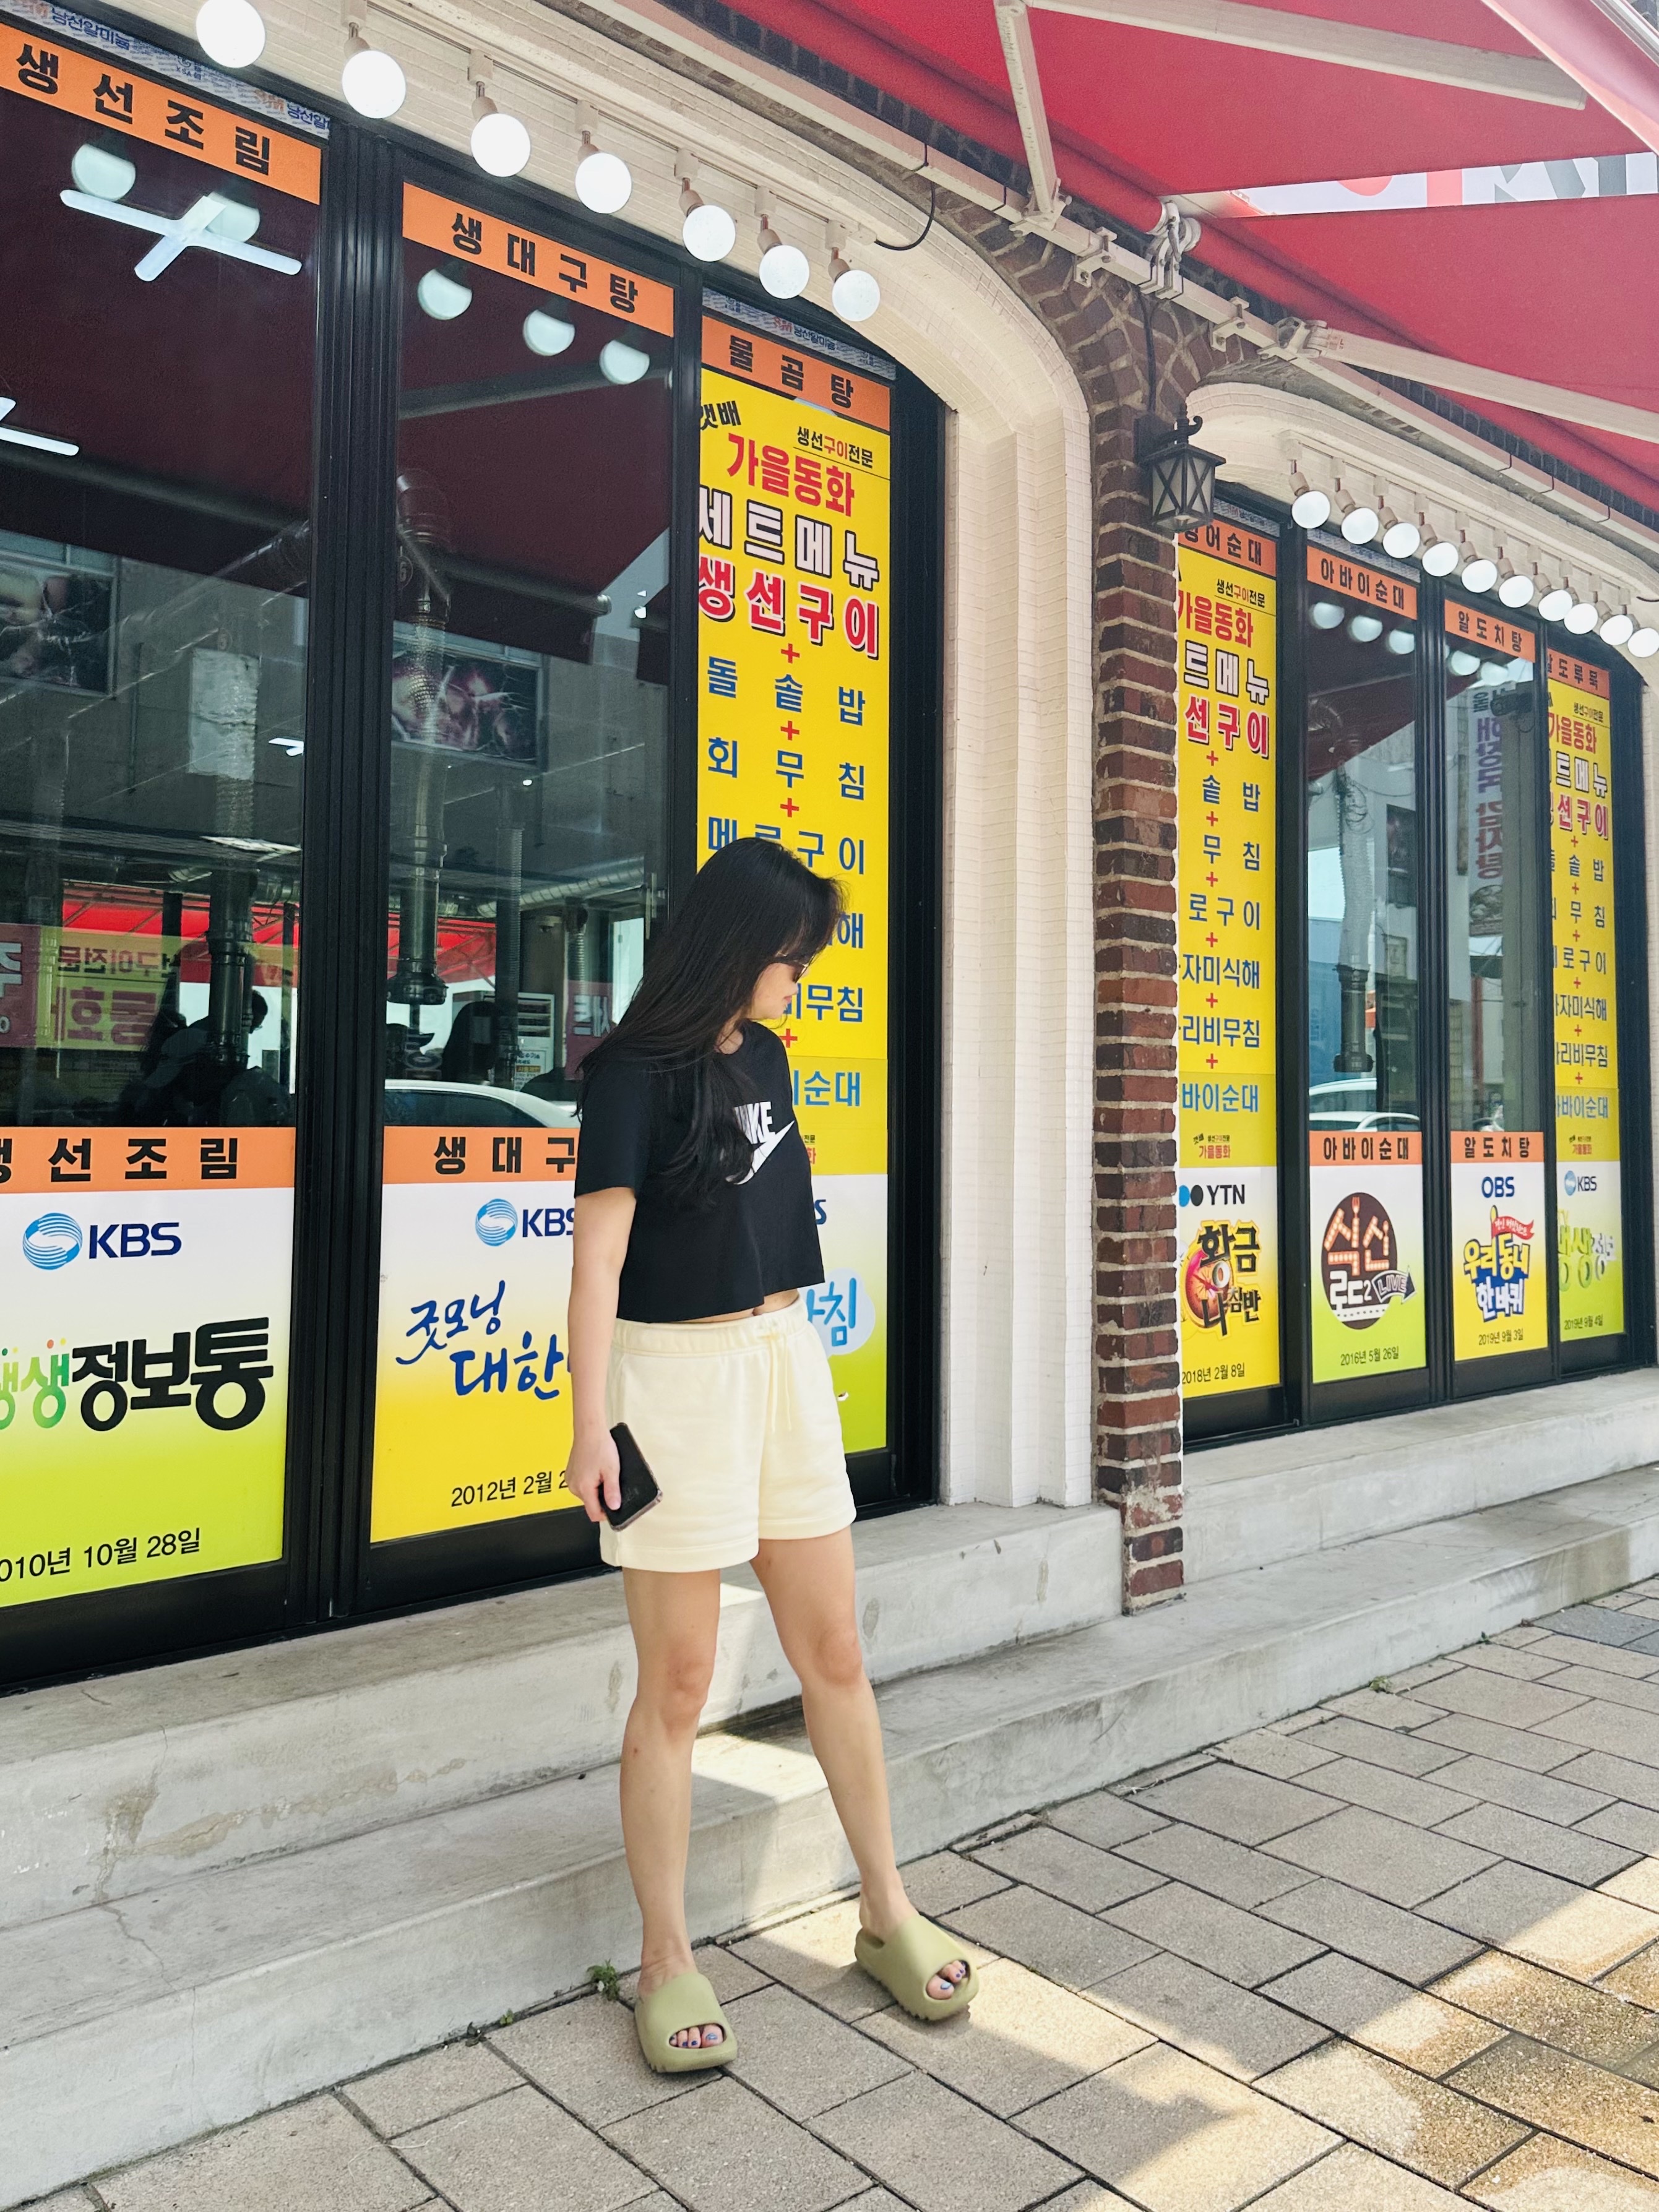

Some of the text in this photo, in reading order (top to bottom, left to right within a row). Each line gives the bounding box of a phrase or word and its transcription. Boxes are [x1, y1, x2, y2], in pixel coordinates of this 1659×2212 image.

[52, 7, 130, 51] 남선알미늄
[287, 100, 330, 130] 남선알
[729, 335, 853, 408] 물곰탕
[798, 426, 873, 468] 생선구이전문
[726, 433, 855, 517] 가을동화
[699, 485, 879, 592] 세트메뉴
[1217, 579, 1265, 608] 생선구이전문
[1321, 558, 1405, 610] 아바이순대
[699, 554, 879, 660] 생선구이
[1458, 611, 1522, 653] 알도치탕
[1548, 712, 1597, 754] 가을동화
[1549, 749, 1608, 799] 트메뉴
[1550, 792, 1609, 840] 선구이
[1179, 953, 1260, 989] 자미식해
[1553, 946, 1607, 975] 로구이
[1179, 1015, 1260, 1048] 리비무침
[734, 1101, 775, 1145] IKE
[0, 1137, 239, 1183] 선조림
[1199, 1145, 1231, 1159] 가을동화
[1324, 1137, 1408, 1161] 아바이순대
[1465, 1136, 1530, 1159] 알도치탕
[1206, 1184, 1245, 1205] YTN
[1481, 1176, 1515, 1198] OBS
[1577, 1176, 1597, 1192] KBS
[89, 1221, 182, 1259] KBS
[1197, 1223, 1261, 1288] 황금
[1324, 1197, 1390, 1276] 식신
[396, 1280, 506, 1365] 굿모닝
[1201, 1287, 1261, 1336] 나침반
[1340, 1346, 1399, 1366] 2016년 5월 26일
[1479, 1328, 1523, 1345] 2019년 9월 3일
[449, 1330, 571, 1400] 대한
[1182, 1362, 1245, 1384] 2018년 2월 8일
[451, 1477, 515, 1507] 2012년
[524, 1471, 552, 1494] 2월
[84, 1537, 137, 1569] 10월
[147, 1528, 200, 1558] 28일
